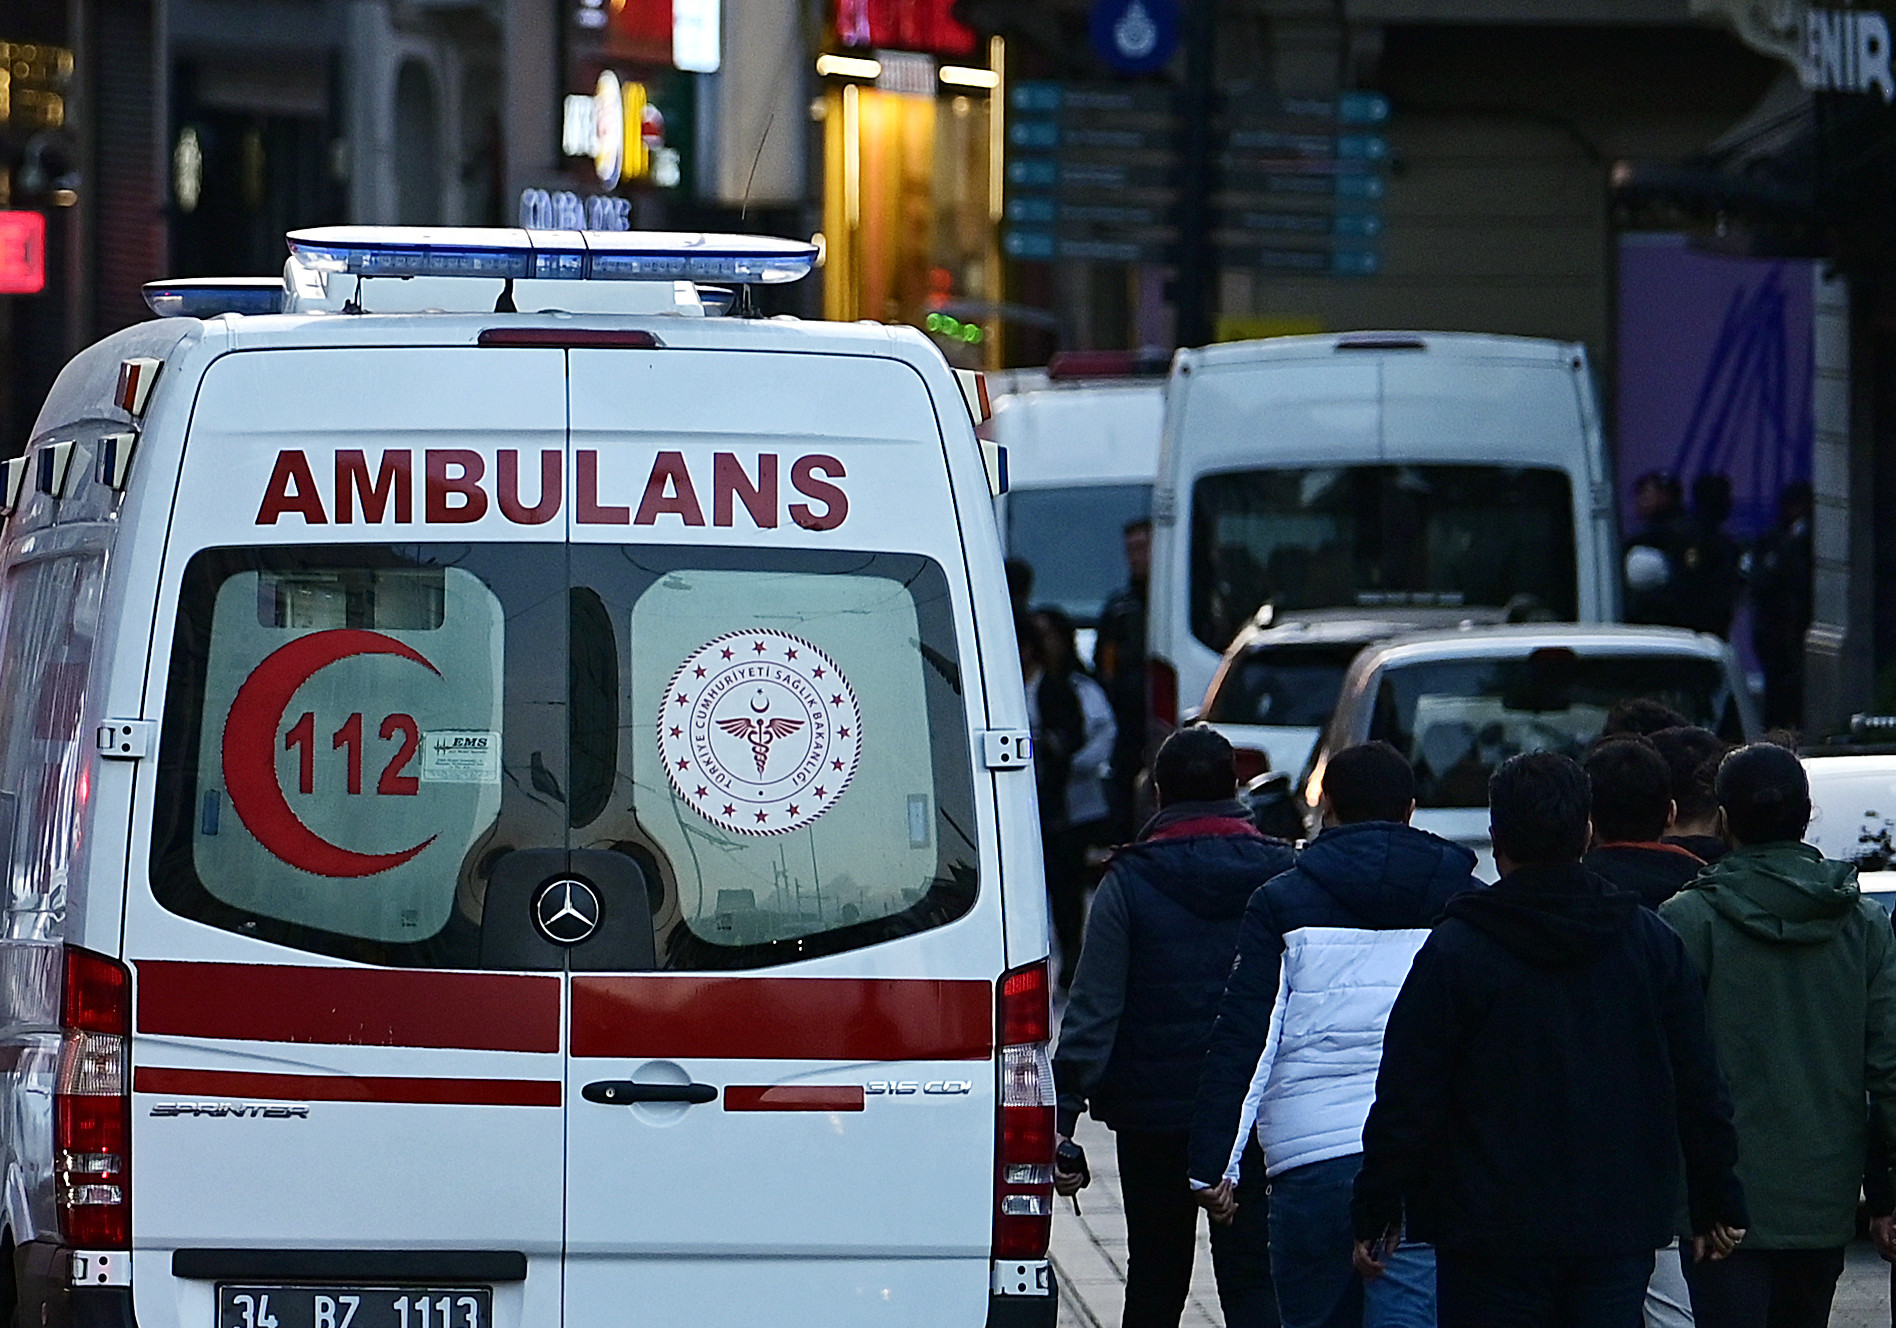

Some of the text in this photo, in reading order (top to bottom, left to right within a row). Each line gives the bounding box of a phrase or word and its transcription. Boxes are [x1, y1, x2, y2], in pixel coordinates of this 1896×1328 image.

[254, 448, 850, 533] AMBULANS
[453, 737, 488, 747] EMS
[695, 665, 826, 790] TÜRKİYE CUMHURİYETİ SAĞLIK BAKANLIĞI
[285, 711, 419, 795] 112
[149, 1102, 311, 1119] SPRINTER
[865, 1080, 972, 1096] 315 CDI
